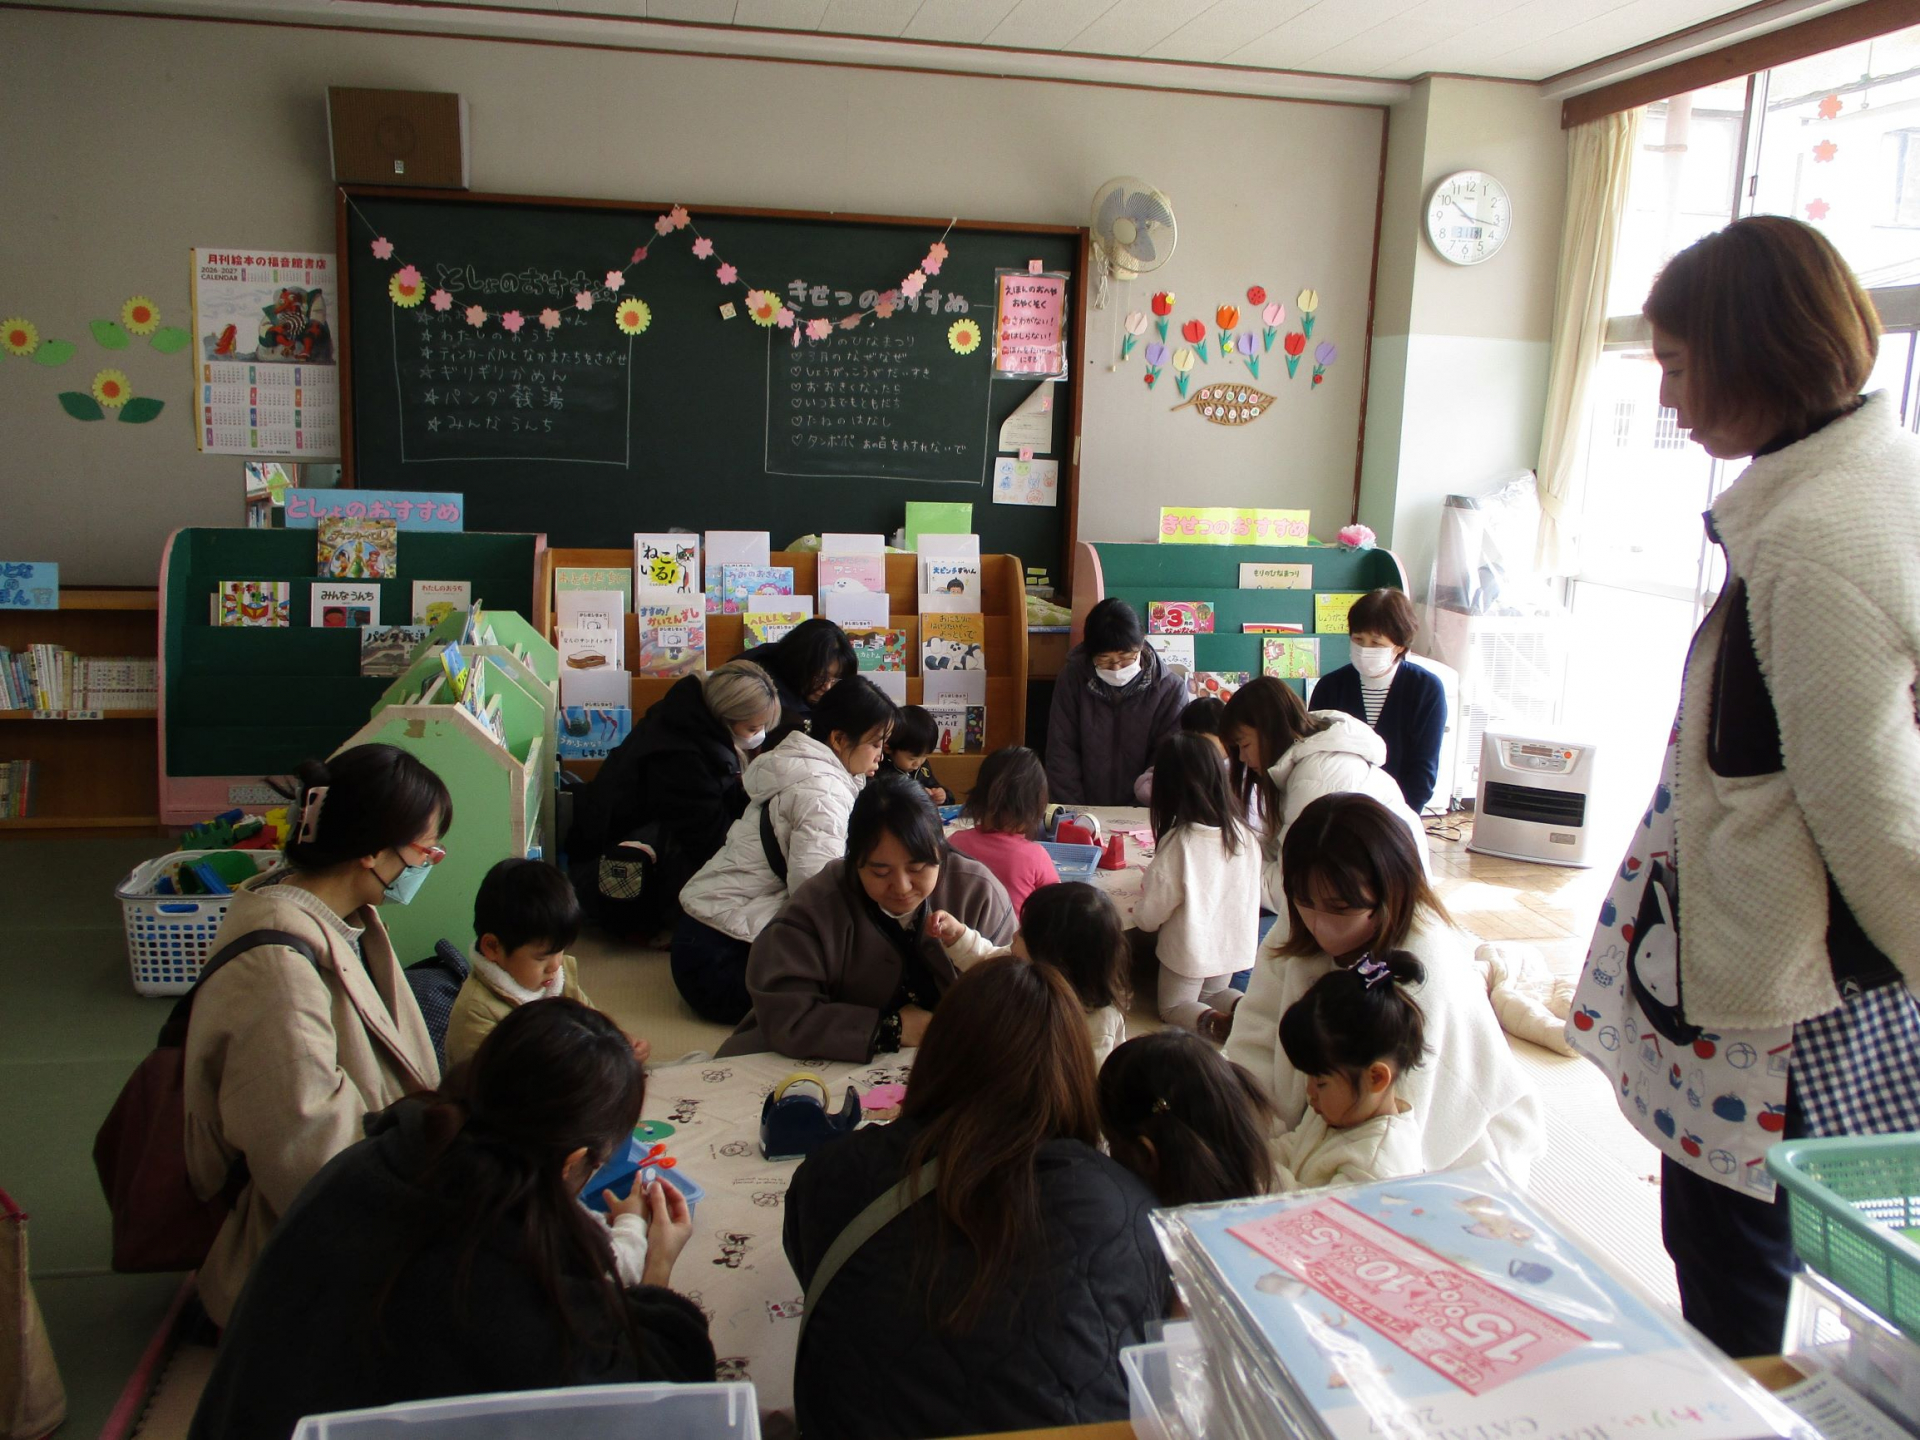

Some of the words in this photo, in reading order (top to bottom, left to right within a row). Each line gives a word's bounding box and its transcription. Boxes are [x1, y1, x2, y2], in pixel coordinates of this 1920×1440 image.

[1452, 184, 1461, 195] 11
[1466, 181, 1476, 192] 12
[1441, 195, 1452, 206] 10
[1490, 197, 1498, 208] 2
[1436, 210, 1443, 221] 9
[1493, 214, 1500, 225] 3
[1439, 228, 1446, 239] 8
[1488, 229, 1494, 240] 4
[1450, 239, 1456, 251] 7
[1461, 243, 1469, 255] 6
[1477, 241, 1484, 252] 5
[208, 254, 327, 270] 月刊絵本の福音館書店
[201, 274, 238, 282] CALENDAR
[1005, 285, 1058, 297] えほんのおへや
[1012, 299, 1047, 309] おやくそく
[441, 365, 567, 383] ギリギリかめん
[807, 382, 901, 396] おおきくなったら
[445, 388, 565, 410] パンダ銭湯
[806, 397, 901, 411] いつまでもともだち
[807, 414, 892, 428] たねのはなし
[286, 494, 461, 524] としょのおすすめ
[1160, 514, 1309, 538] きせつのおすすめ
[642, 544, 672, 565] ねこ
[0, 563, 34, 579] とな
[932, 566, 977, 575] 大ピンチずかん
[1253, 569, 1300, 578] もりのひなまつり
[421, 585, 463, 593] わたしのおうち
[321, 590, 375, 602] みんなうんち
[1349, 1244, 1418, 1294] 10%
[1426, 1288, 1542, 1366] 15%
